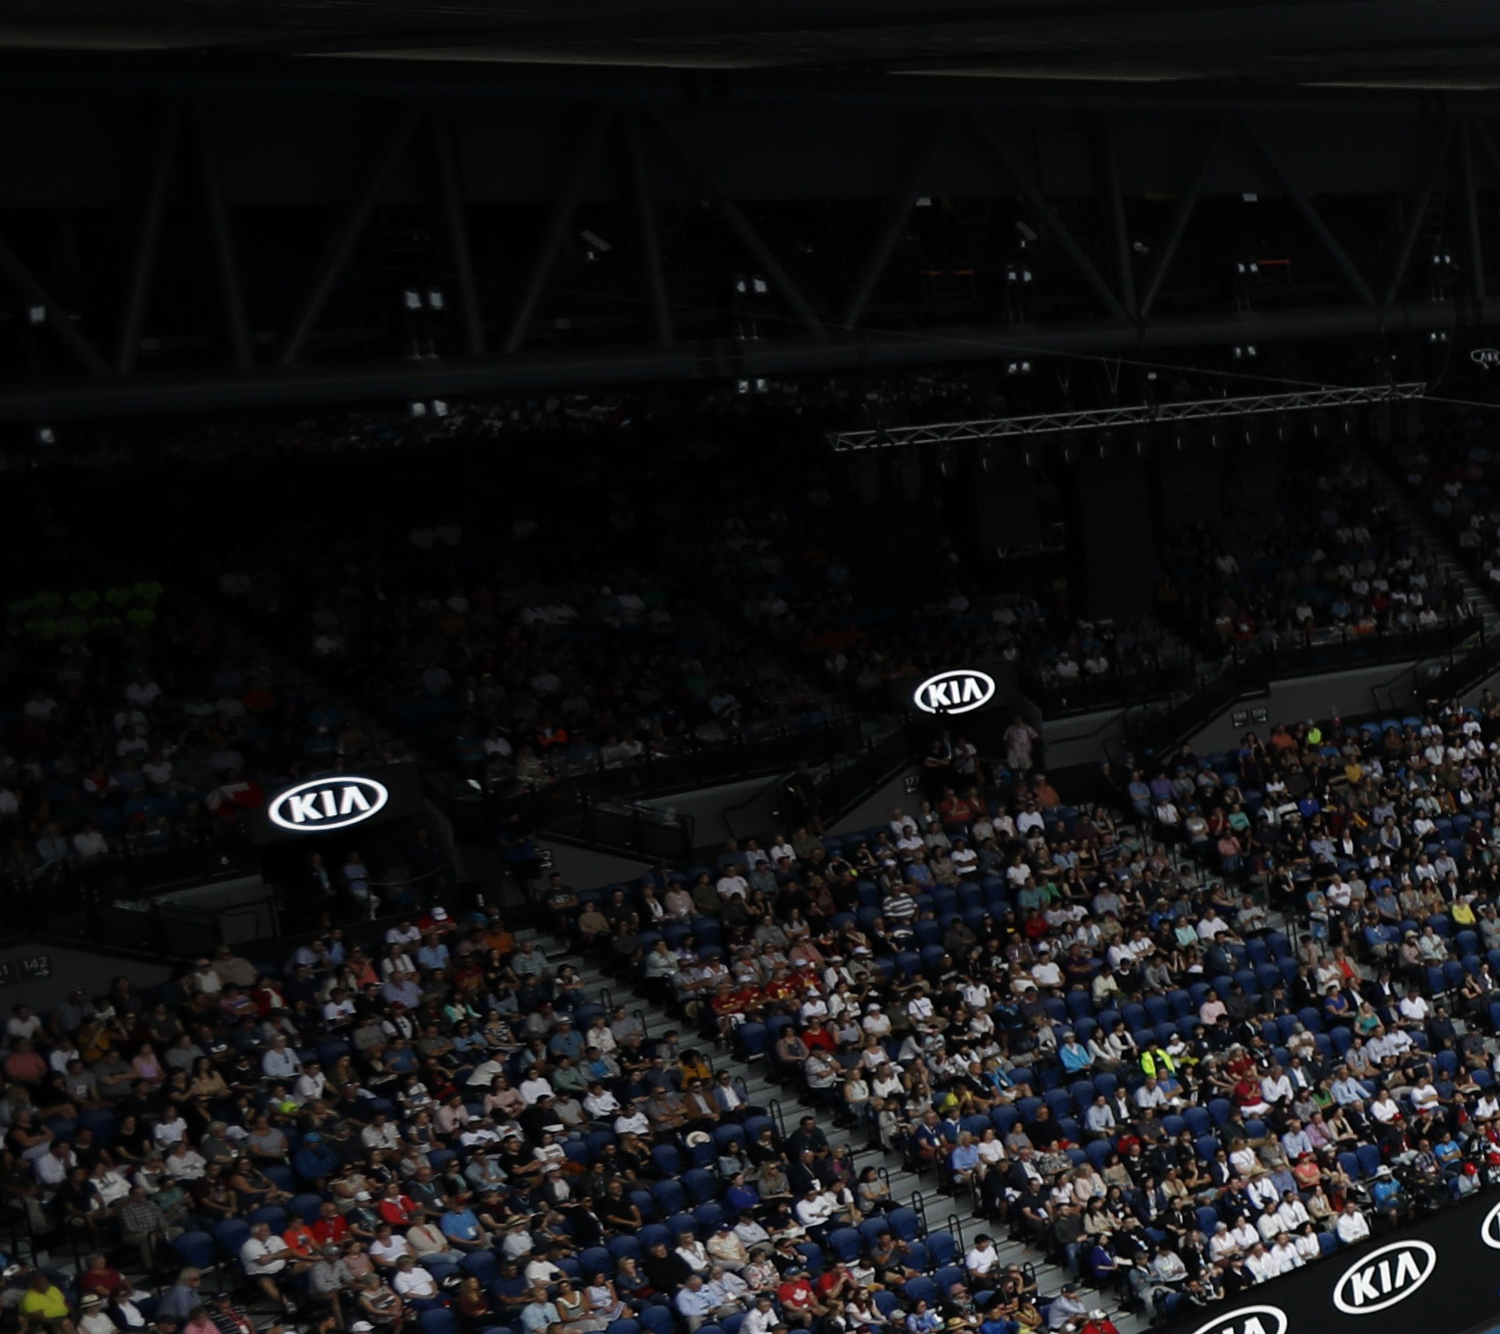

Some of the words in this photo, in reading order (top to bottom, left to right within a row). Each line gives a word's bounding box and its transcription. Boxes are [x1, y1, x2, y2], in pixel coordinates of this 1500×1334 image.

[928, 677, 984, 708] KIA
[289, 785, 372, 823] KIA
[1351, 1250, 1421, 1306] KIA
